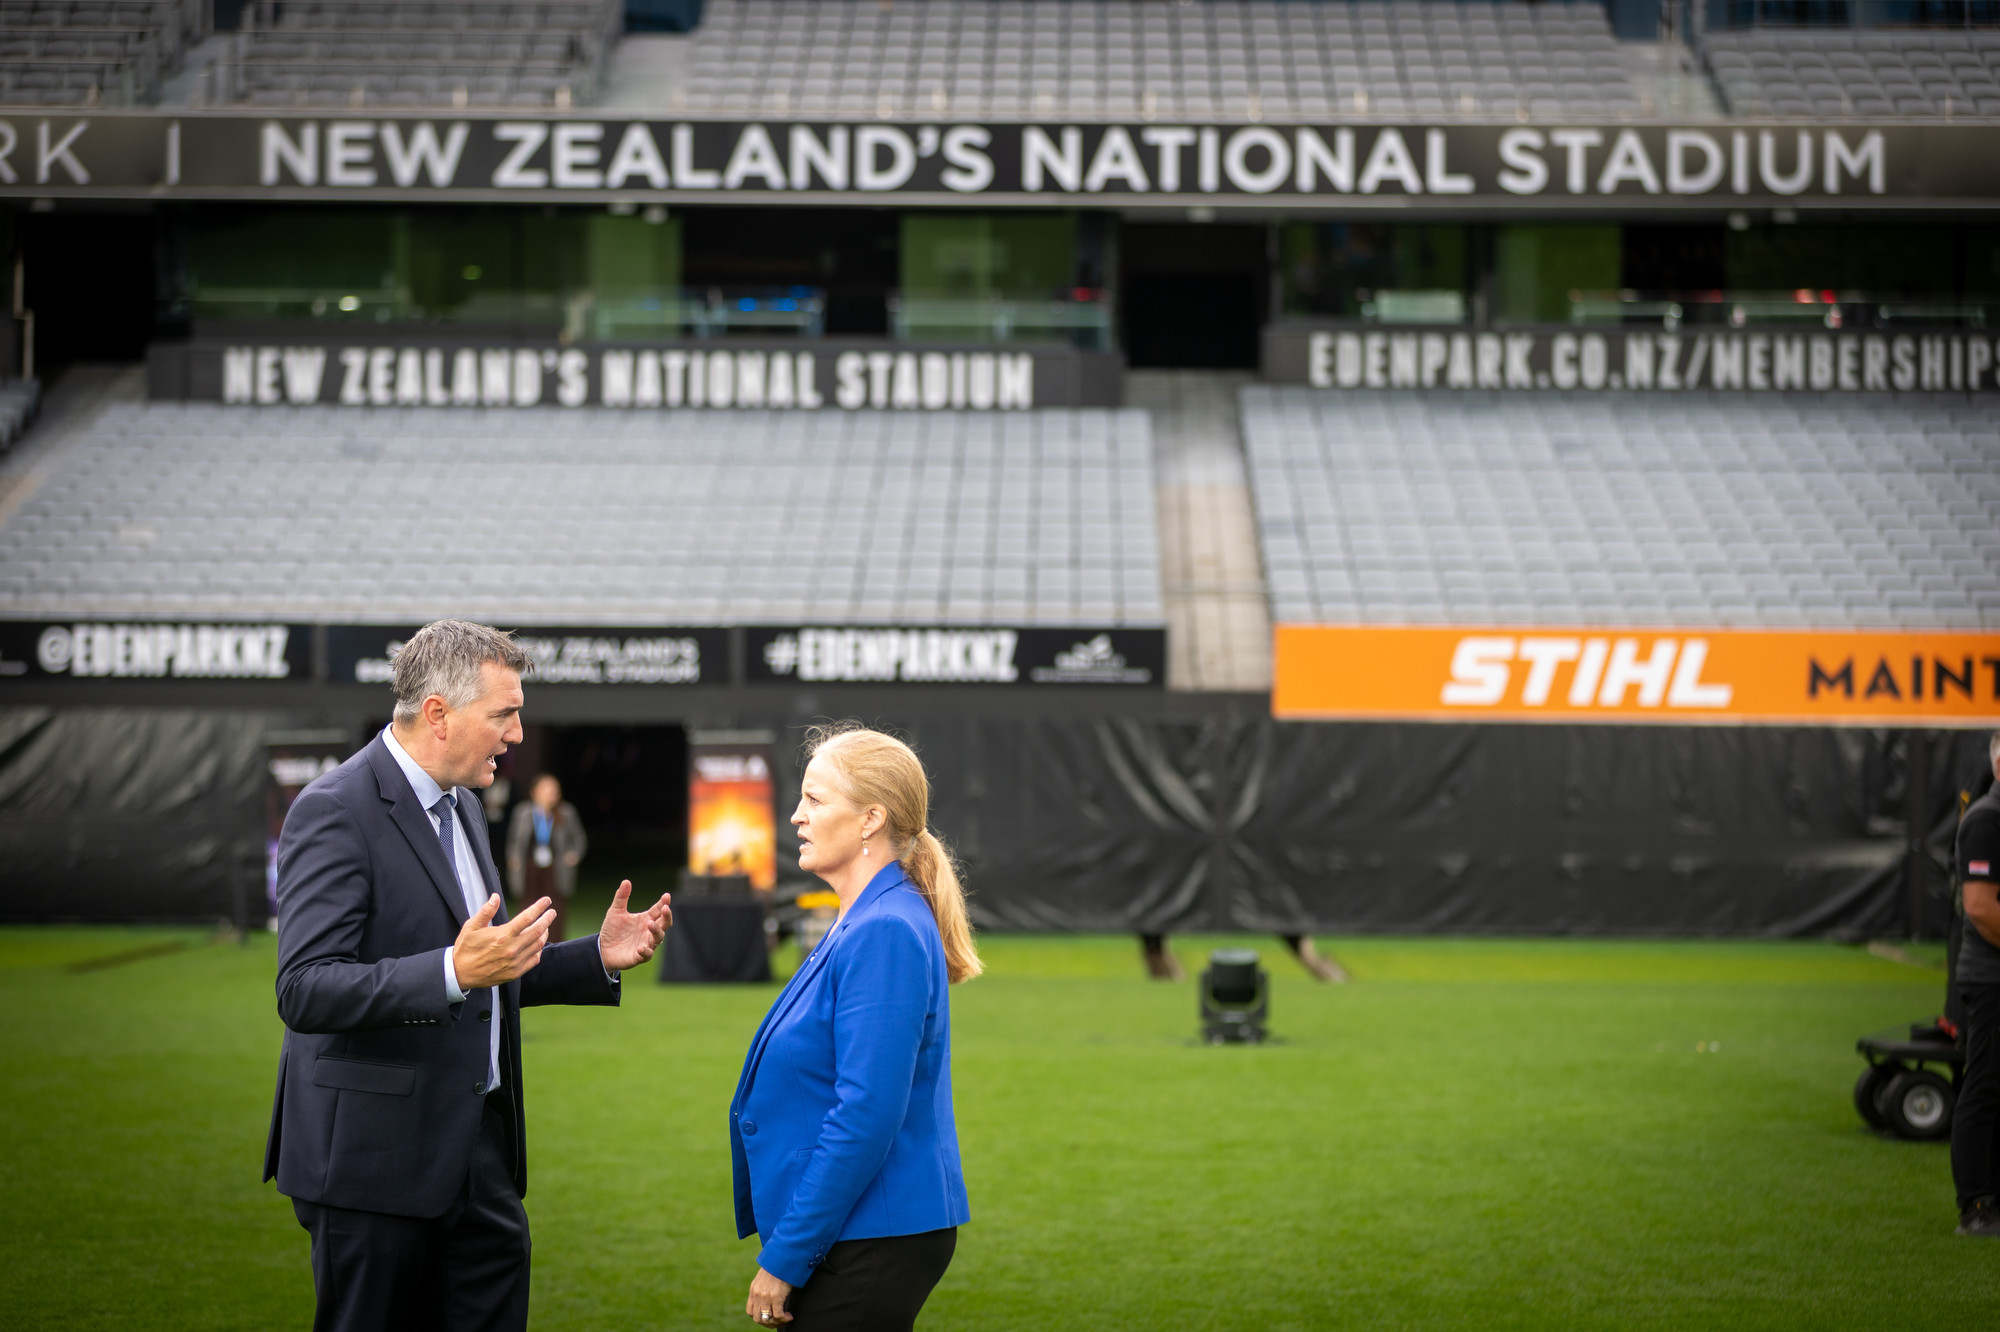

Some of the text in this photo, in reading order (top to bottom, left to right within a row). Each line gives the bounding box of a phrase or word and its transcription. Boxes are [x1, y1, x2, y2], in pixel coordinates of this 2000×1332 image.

[261, 121, 469, 187] NEW
[492, 122, 995, 191] ZEALAND'S
[1021, 126, 1475, 194] NATIONAL
[1497, 128, 1886, 195] STADIUM
[223, 347, 1034, 409] NEW ZEALAND'S NATIONAL STADIUM
[1309, 332, 2000, 391] EDENPARK.CO.NZ/MEMBERSHIP
[37, 624, 290, 678] @EDENPARKNZ
[763, 628, 1019, 682] #EDENPARKNZ
[1440, 635, 1733, 708] STIHL
